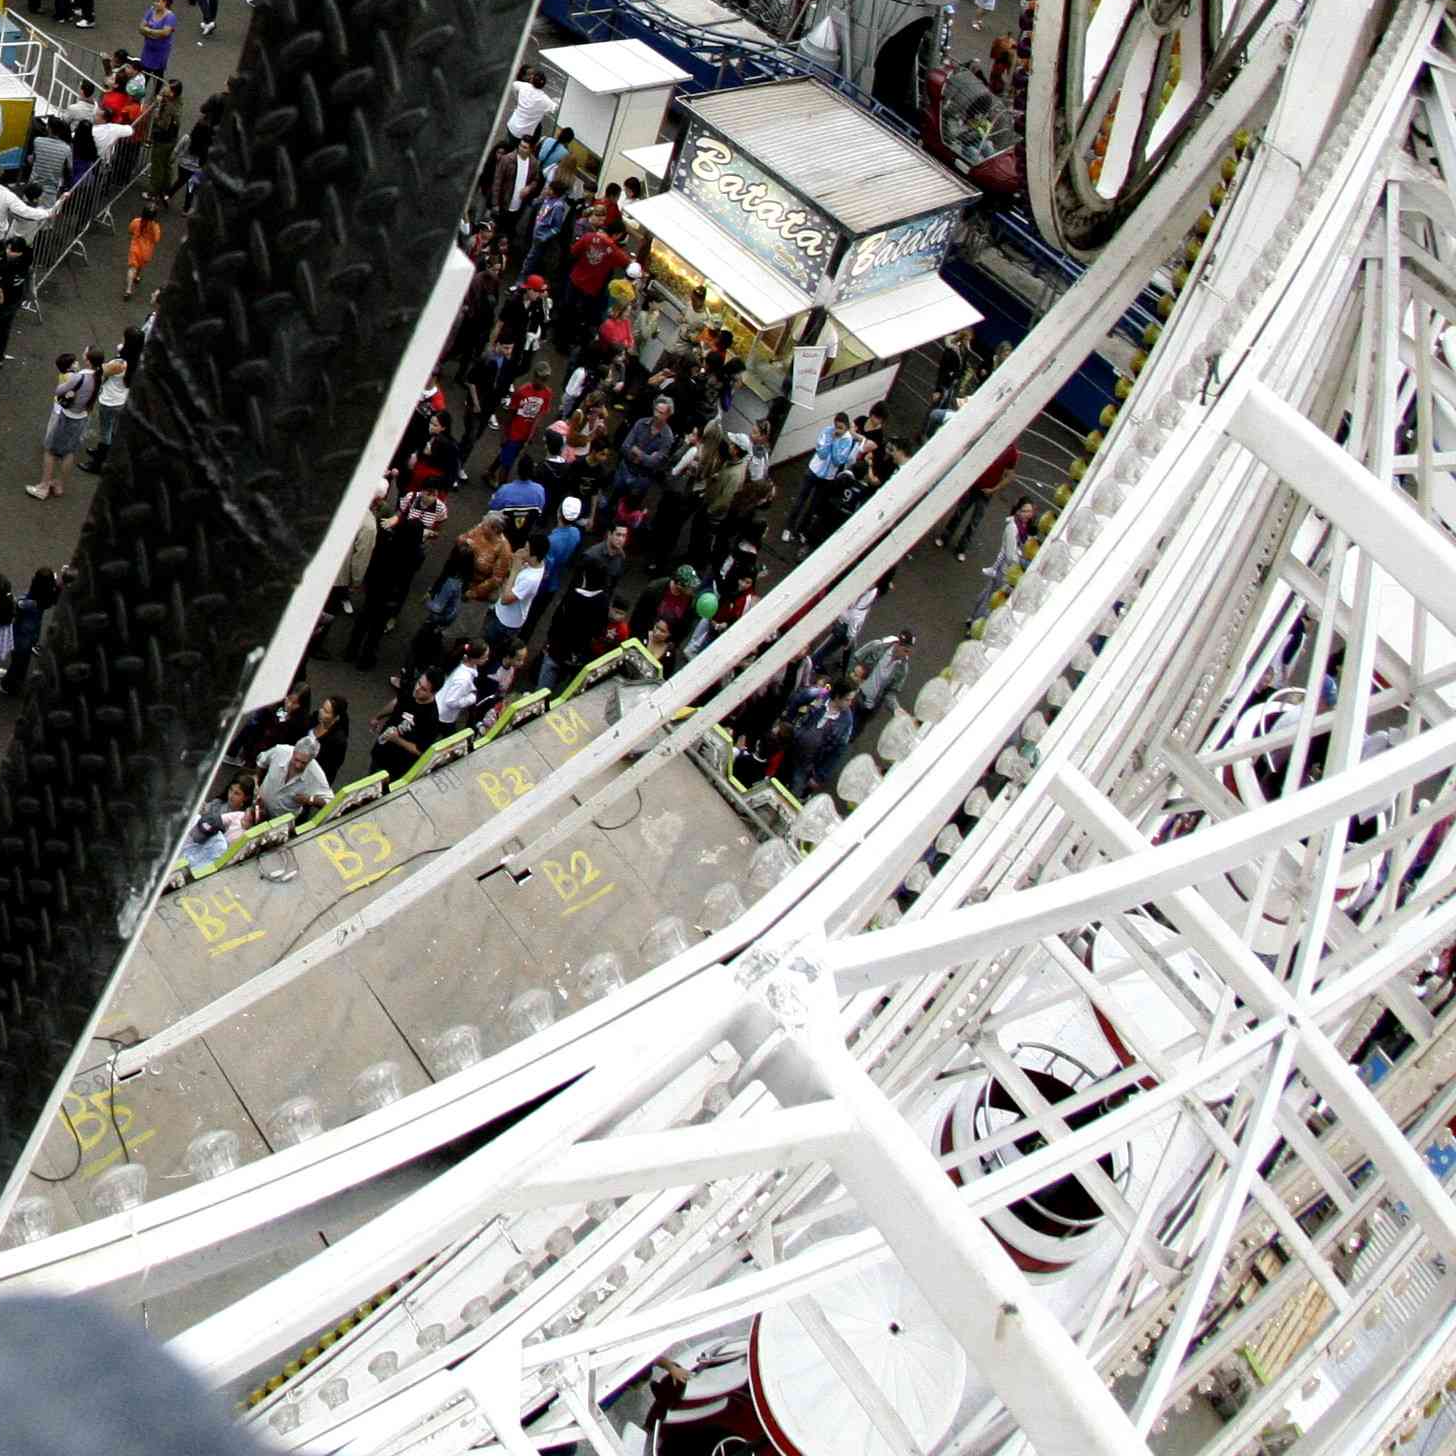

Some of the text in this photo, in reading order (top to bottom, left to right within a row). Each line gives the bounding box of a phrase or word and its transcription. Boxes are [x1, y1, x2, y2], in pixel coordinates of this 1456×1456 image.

[691, 136, 824, 257] Batata
[851, 219, 950, 276] Batata
[317, 821, 392, 881] B3
[541, 850, 601, 902] B2
[179, 885, 255, 942] B4
[58, 1084, 136, 1153] B5
